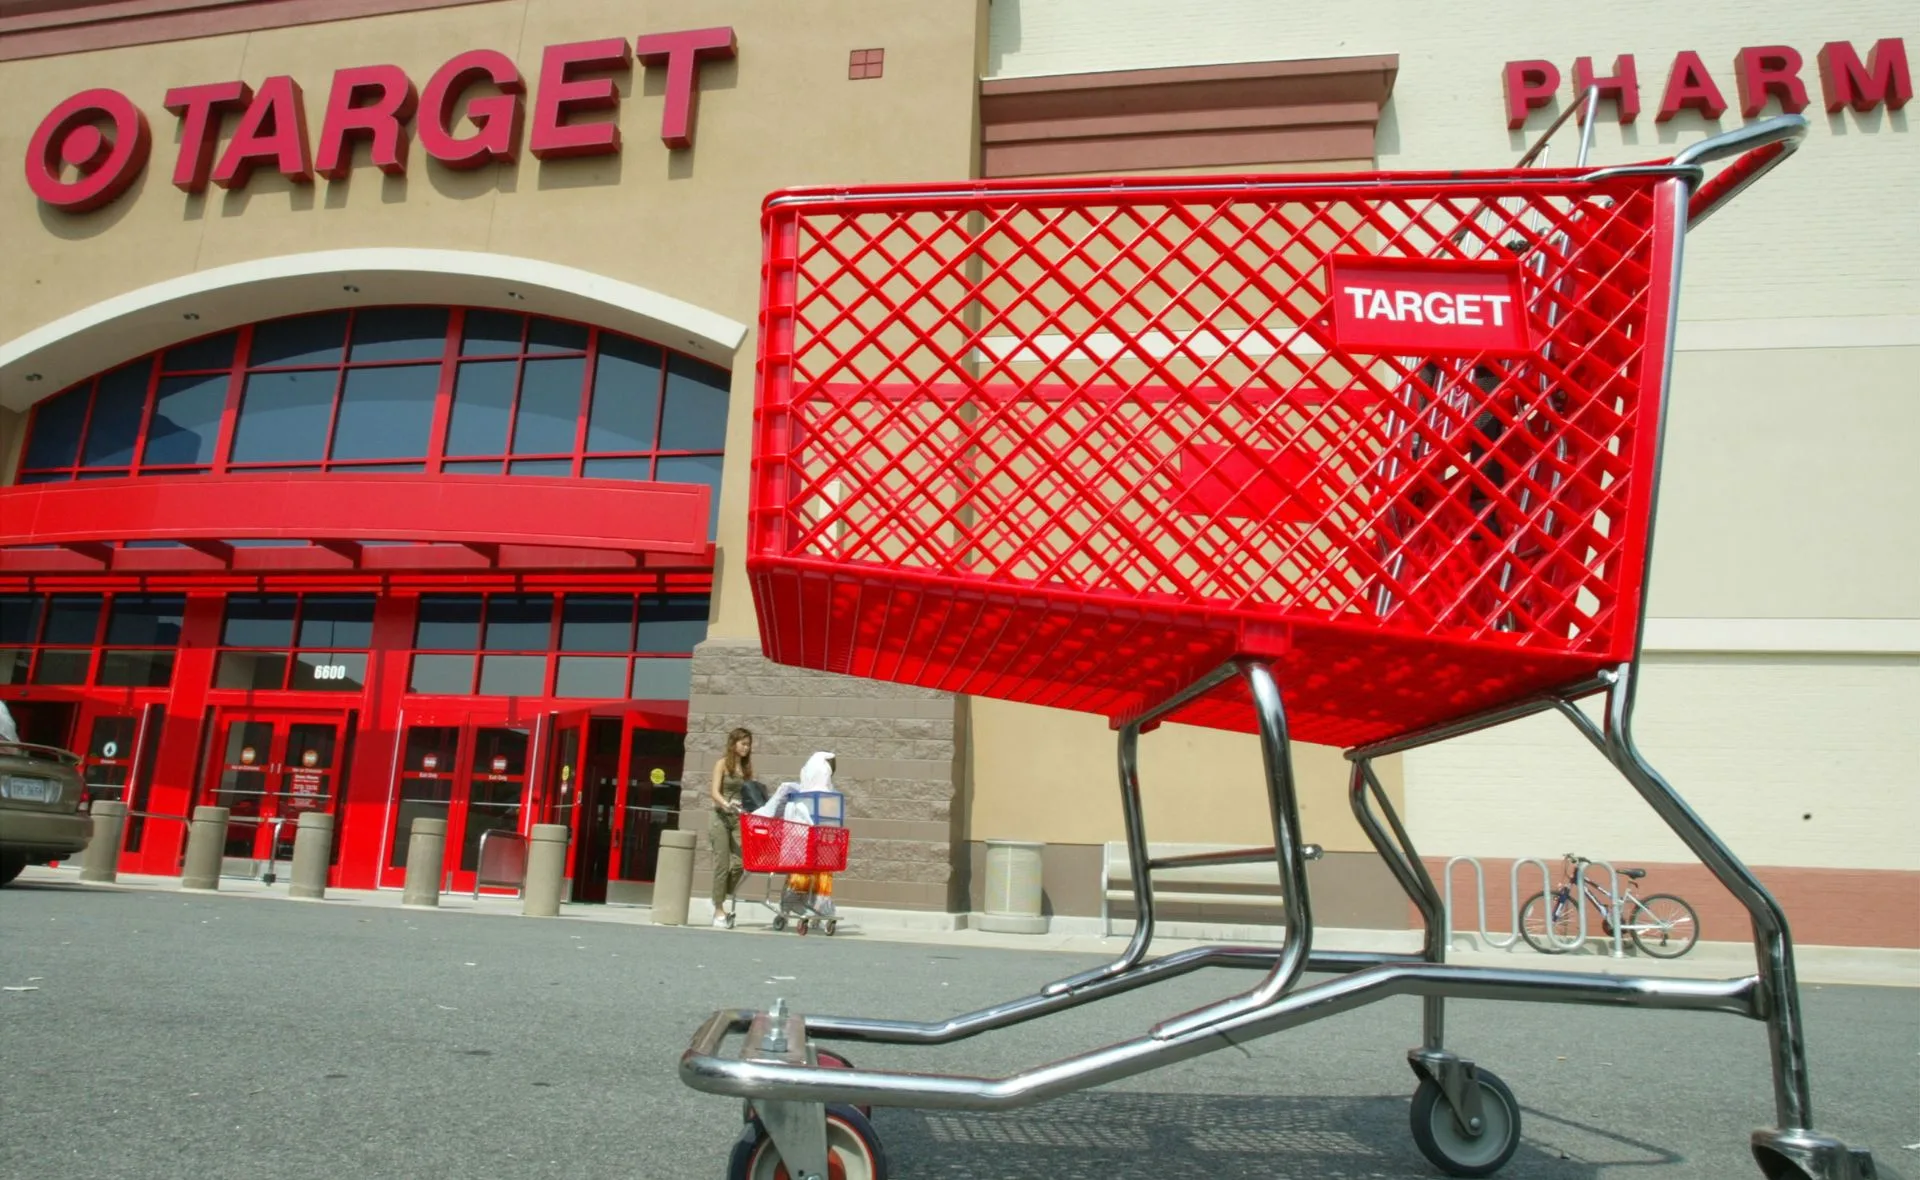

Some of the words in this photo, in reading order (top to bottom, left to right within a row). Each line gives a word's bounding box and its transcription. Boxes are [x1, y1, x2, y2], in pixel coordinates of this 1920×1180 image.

[163, 26, 737, 193] TARGET
[1501, 37, 1913, 130] PHARM
[1344, 286, 1511, 326] TARGET
[314, 665, 346, 679] 6600
